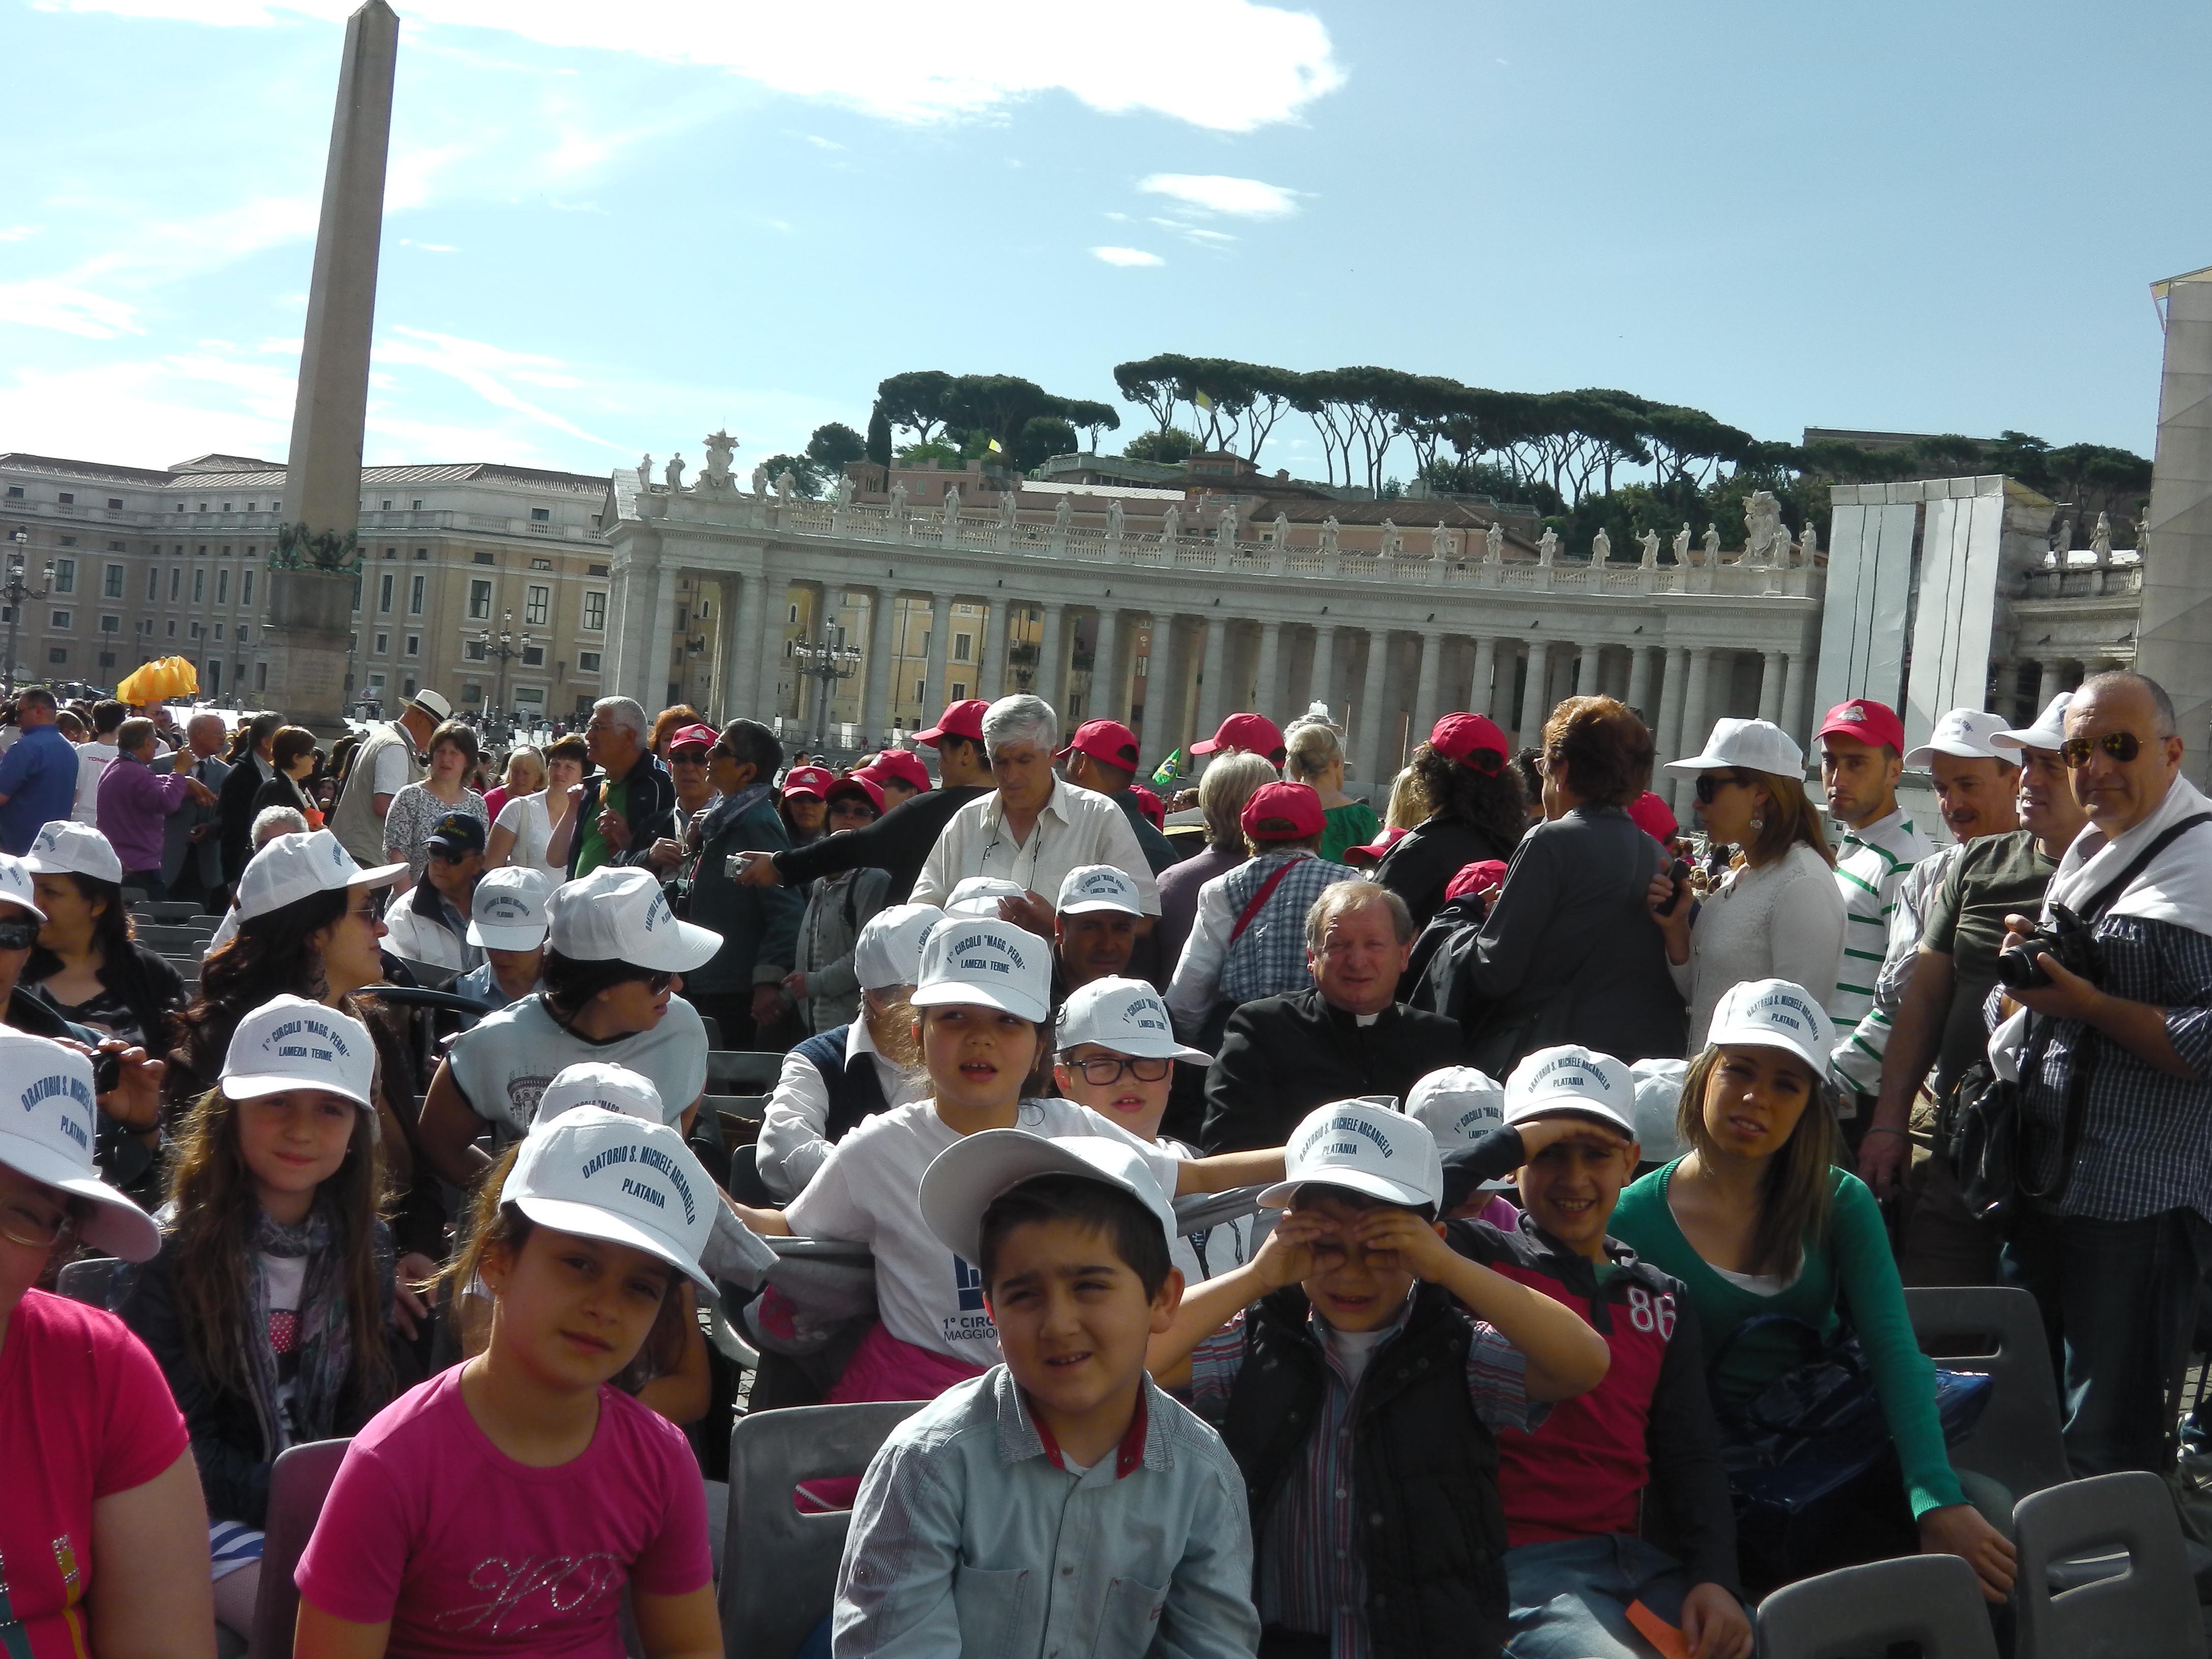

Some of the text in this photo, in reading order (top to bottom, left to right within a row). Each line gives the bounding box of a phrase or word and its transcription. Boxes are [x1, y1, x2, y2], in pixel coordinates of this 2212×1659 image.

[947, 935, 1026, 970] 1° CIRCOLO "MAGG. PERRI"
[961, 959, 1010, 974] LAMEZIA TERME
[1122, 1013, 1130, 1024] 1°
[1127, 998, 1146, 1016] CIRCOLO
[1138, 1020, 1156, 1028] LAMEZIA
[1746, 995, 1819, 1041] ORATORIO S. MICHELE ARCANGELO
[1771, 1012, 1800, 1030] PLATANIA
[262, 1020, 350, 1057] 1° CIRCOLO "MAGG. PERRI"
[279, 1047, 332, 1062] LAMEZIA TERME
[1528, 1057, 1610, 1093] ORATORIO S. MICHELE ARCANGELO
[1553, 1077, 1584, 1087] PLATANIA
[21, 1075, 60, 1112] ORATORIO
[63, 1076, 69, 1096] S.
[1454, 1123, 1460, 1134] 1°
[1461, 1108, 1482, 1127] CIRCOLO
[1300, 1117, 1393, 1162] ORATORIO S. MICHELE ARCANGELO
[1322, 1143, 1357, 1156] PLATANIA
[582, 1145, 696, 1225] ORATORIO S. MICHELE ARCANGELO
[621, 1177, 666, 1209] PLATANIA
[943, 1317, 956, 1329] 1°
[1627, 1285, 1676, 1342] 86
